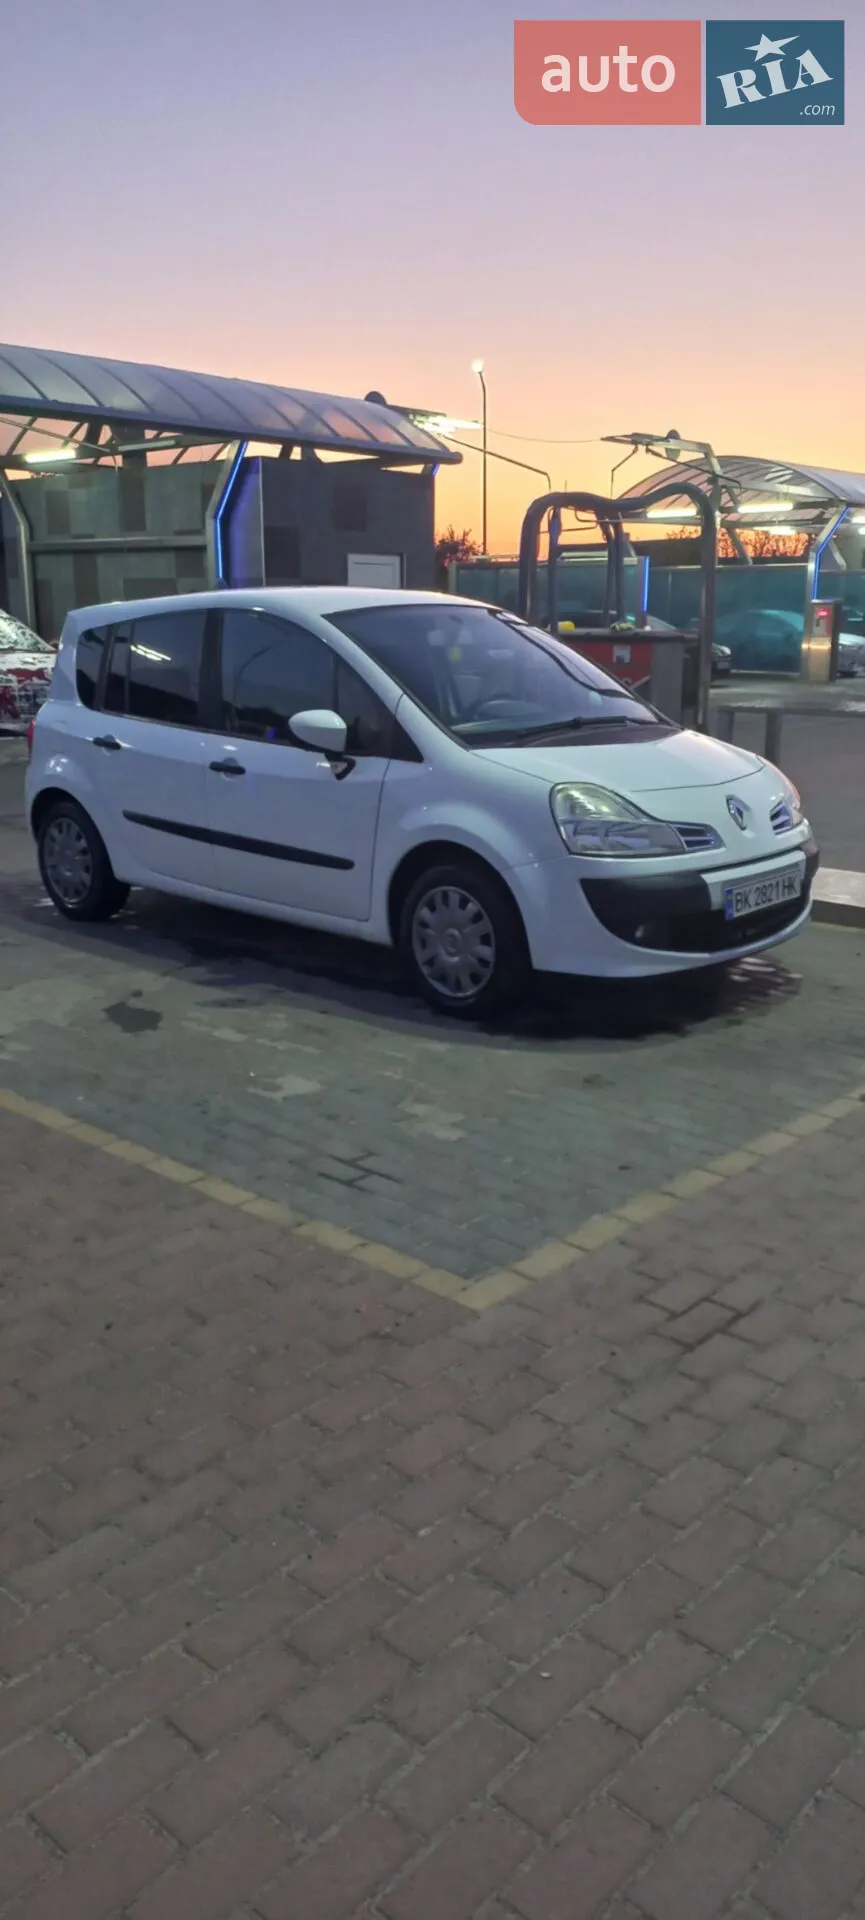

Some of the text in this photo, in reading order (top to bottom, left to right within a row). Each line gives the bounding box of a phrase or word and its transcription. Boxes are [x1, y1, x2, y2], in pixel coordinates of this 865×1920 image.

[735, 889, 752, 912] BK
[754, 880, 780, 906] 2821
[782, 875, 798, 897] HK
